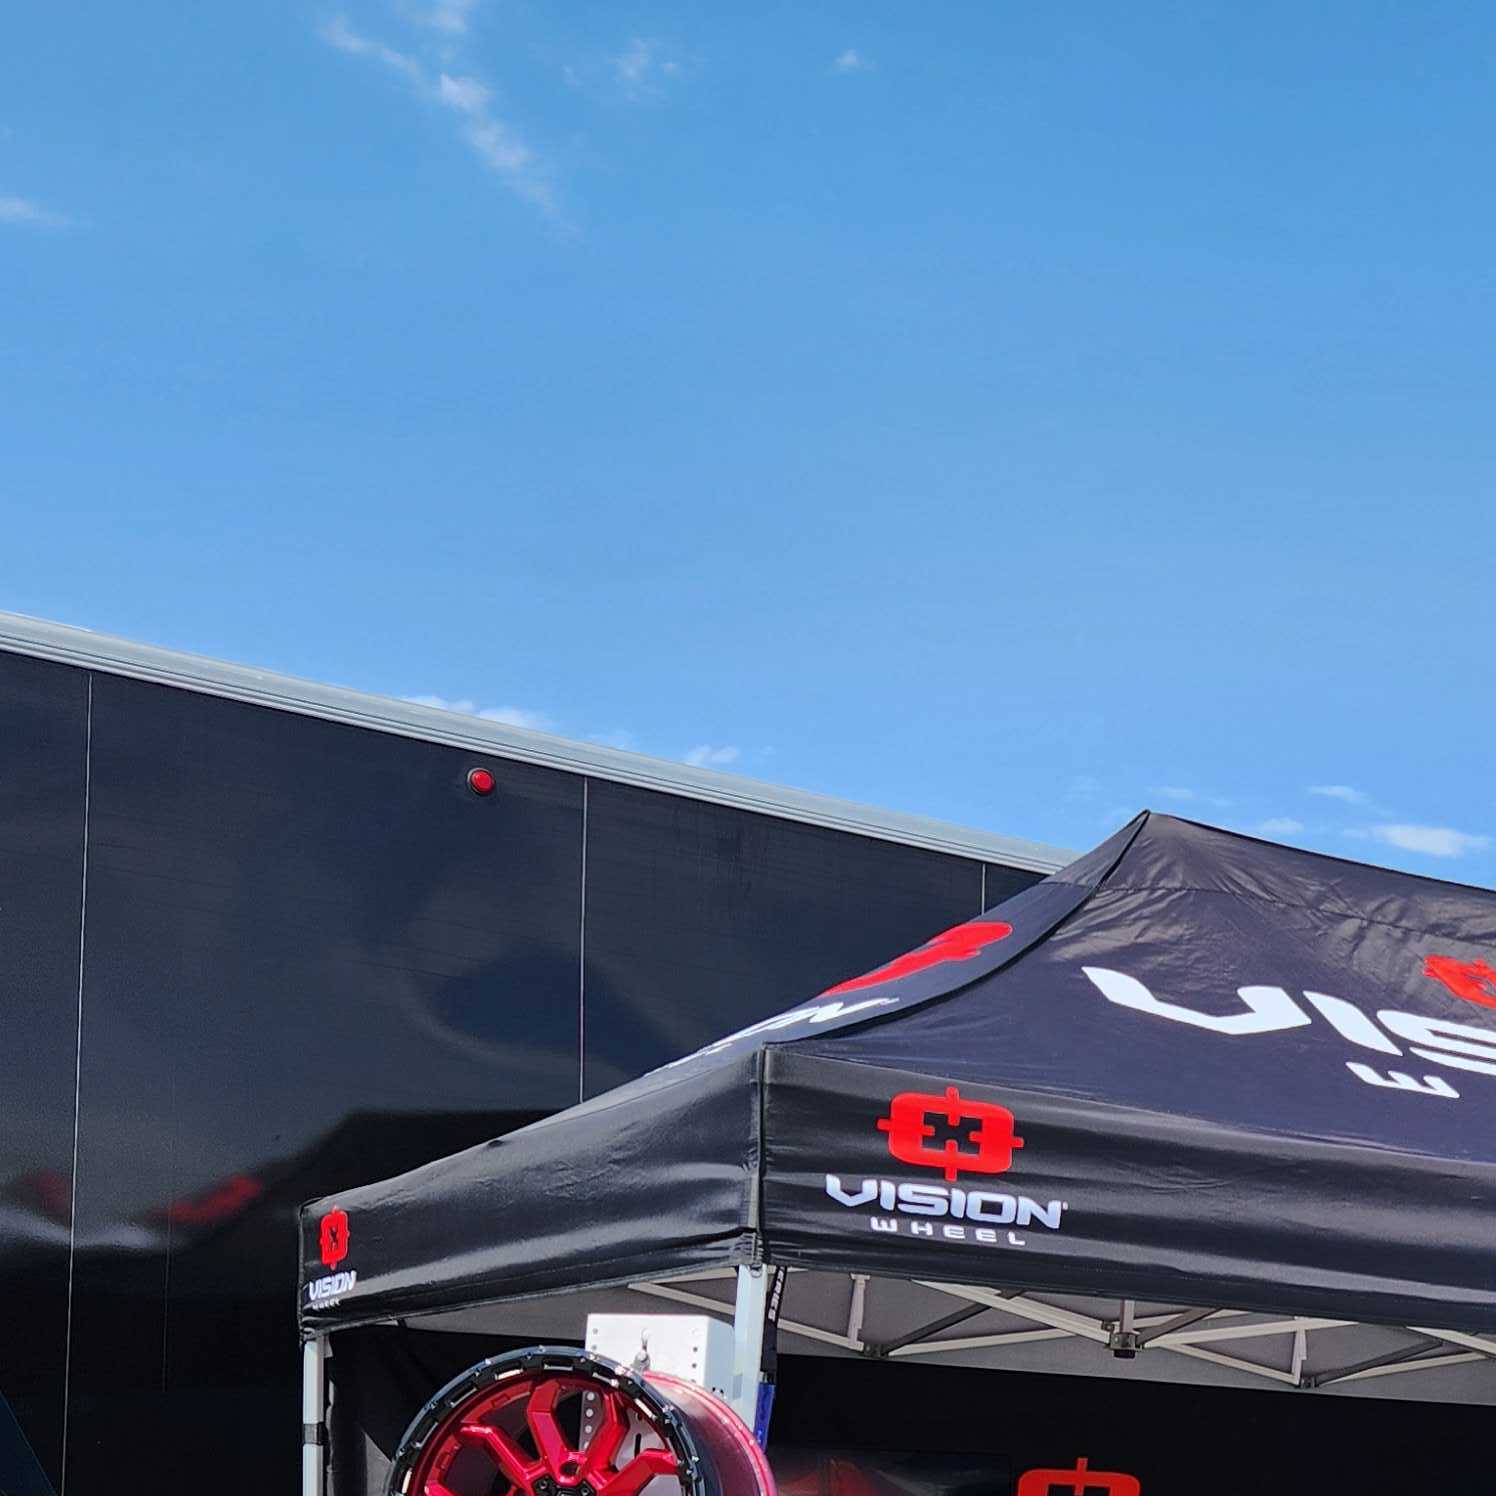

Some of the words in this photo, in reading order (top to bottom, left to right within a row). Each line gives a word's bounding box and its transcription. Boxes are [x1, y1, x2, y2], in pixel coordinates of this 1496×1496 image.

[825, 1173, 1062, 1230] VISION
[870, 1216, 1026, 1246] WHEEL
[309, 1270, 357, 1301] VISION
